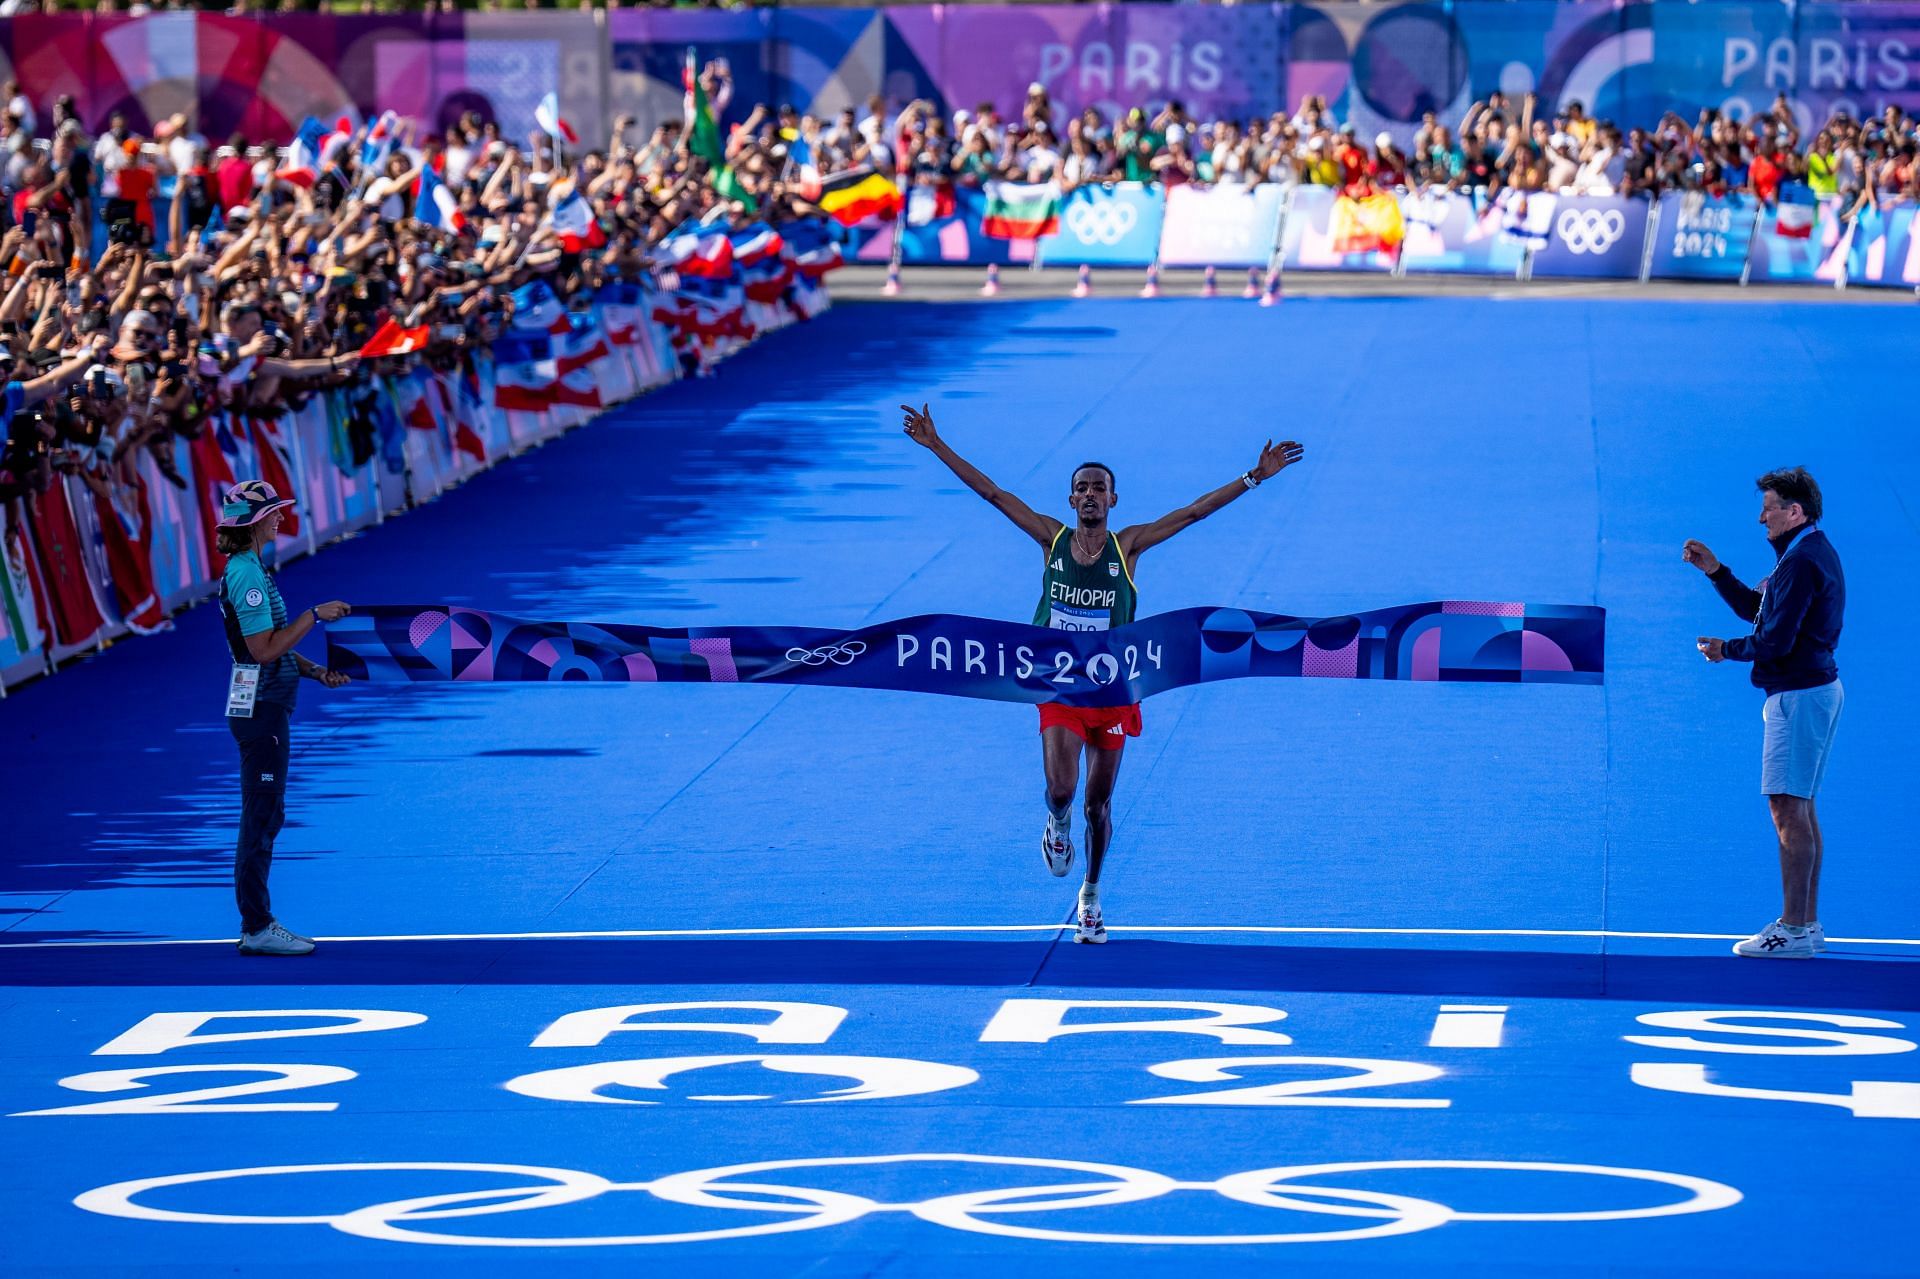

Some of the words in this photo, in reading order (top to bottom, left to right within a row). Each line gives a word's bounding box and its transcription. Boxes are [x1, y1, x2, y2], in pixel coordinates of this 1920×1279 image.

[1673, 231, 1727, 257] 2024
[1050, 581, 1116, 608] ETHIOPIA
[1052, 639, 1162, 686] 2024
[5, 1054, 1920, 1118] 2024
